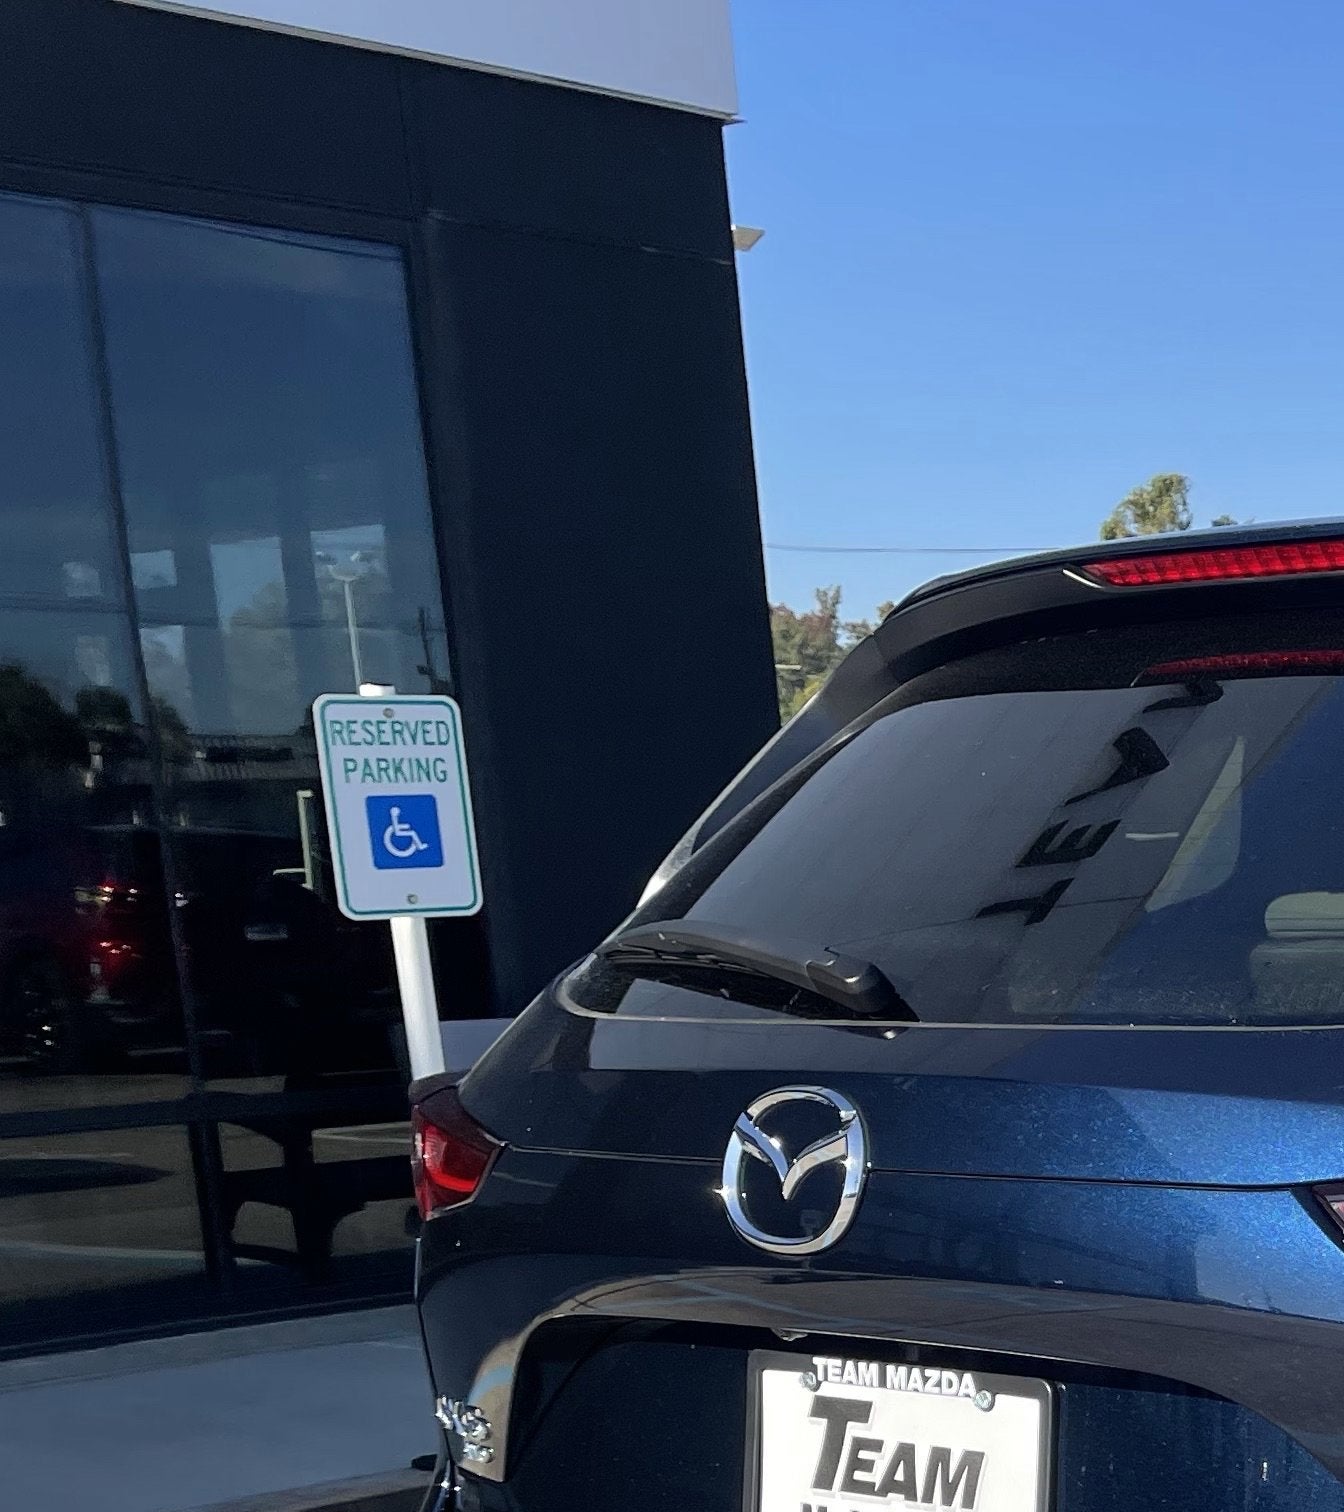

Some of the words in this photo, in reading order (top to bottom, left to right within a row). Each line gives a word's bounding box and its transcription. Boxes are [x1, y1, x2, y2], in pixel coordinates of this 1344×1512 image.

[329, 720, 450, 746] RESERVED
[343, 757, 449, 783] PARKING
[812, 1356, 879, 1388] TEAM
[886, 1364, 977, 1398] MAZDA
